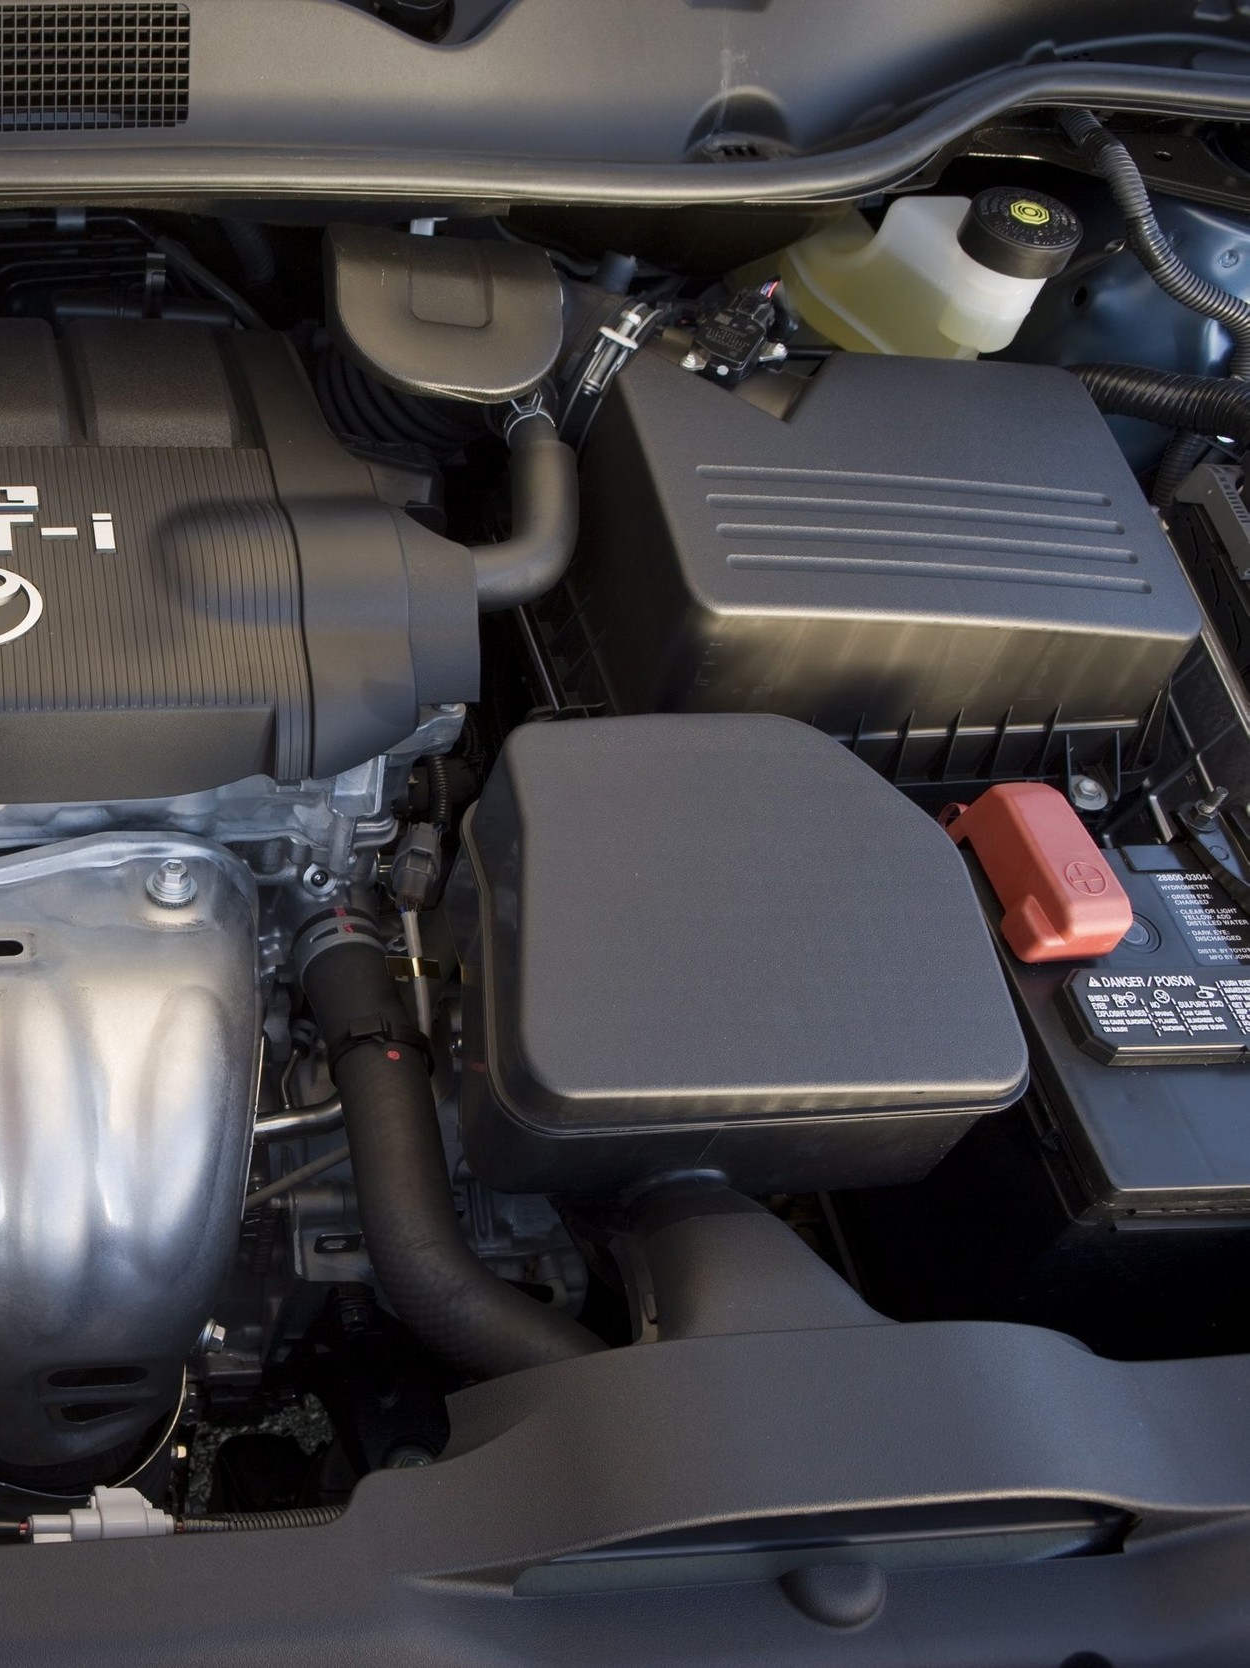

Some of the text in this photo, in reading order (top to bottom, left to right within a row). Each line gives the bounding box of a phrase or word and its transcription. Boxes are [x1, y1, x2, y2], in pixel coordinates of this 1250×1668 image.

[1101, 976, 1146, 988] DANGER
[1154, 975, 1196, 987] POISON
[1087, 994, 1110, 1002] SHIELD
[1091, 1002, 1108, 1010] EYES
[1150, 1001, 1160, 1009] NO
[1178, 1000, 1224, 1009] SULFURIC ACID
